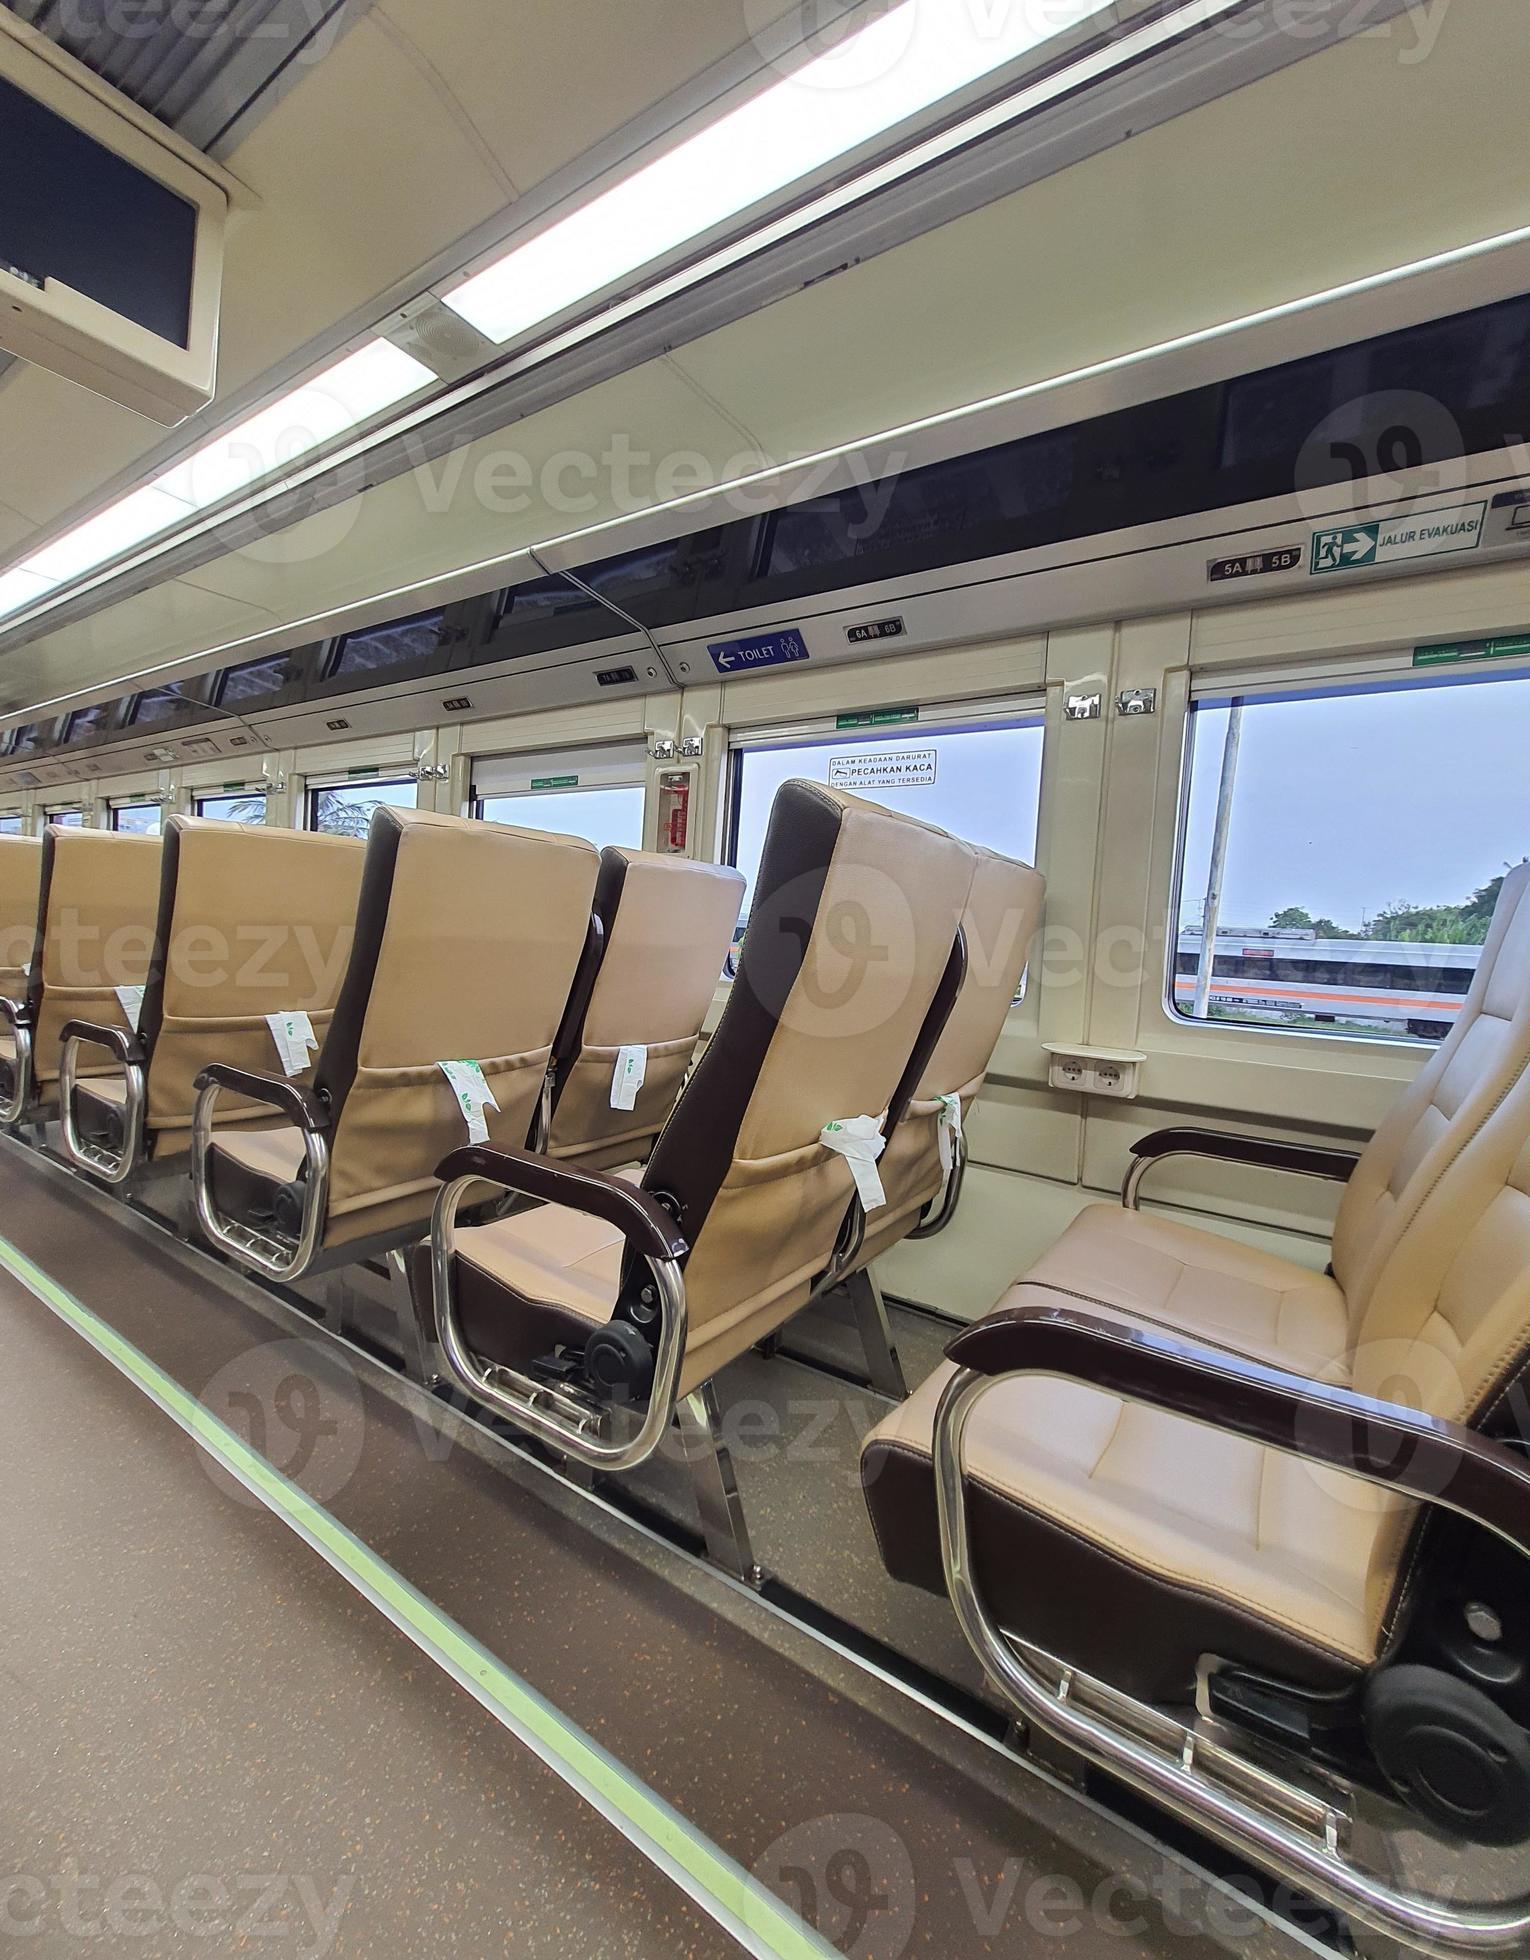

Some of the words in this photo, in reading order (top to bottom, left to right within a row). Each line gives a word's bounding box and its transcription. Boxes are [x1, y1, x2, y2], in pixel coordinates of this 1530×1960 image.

[1378, 530, 1417, 548] JALUR
[1419, 520, 1480, 541] EVAKUASI
[1223, 562, 1243, 575] 5A
[1271, 553, 1291, 568] 5B
[855, 629, 868, 639] 6A
[884, 623, 897, 634] 6B
[738, 646, 774, 662] TOILET
[832, 759, 856, 767] DALAM
[858, 756, 893, 764] KEADAAN
[896, 753, 932, 761] DARURAT
[851, 766, 902, 776] PECAHKAN
[905, 763, 933, 772] KACA
[898, 776, 933, 784] TERSEDIA
